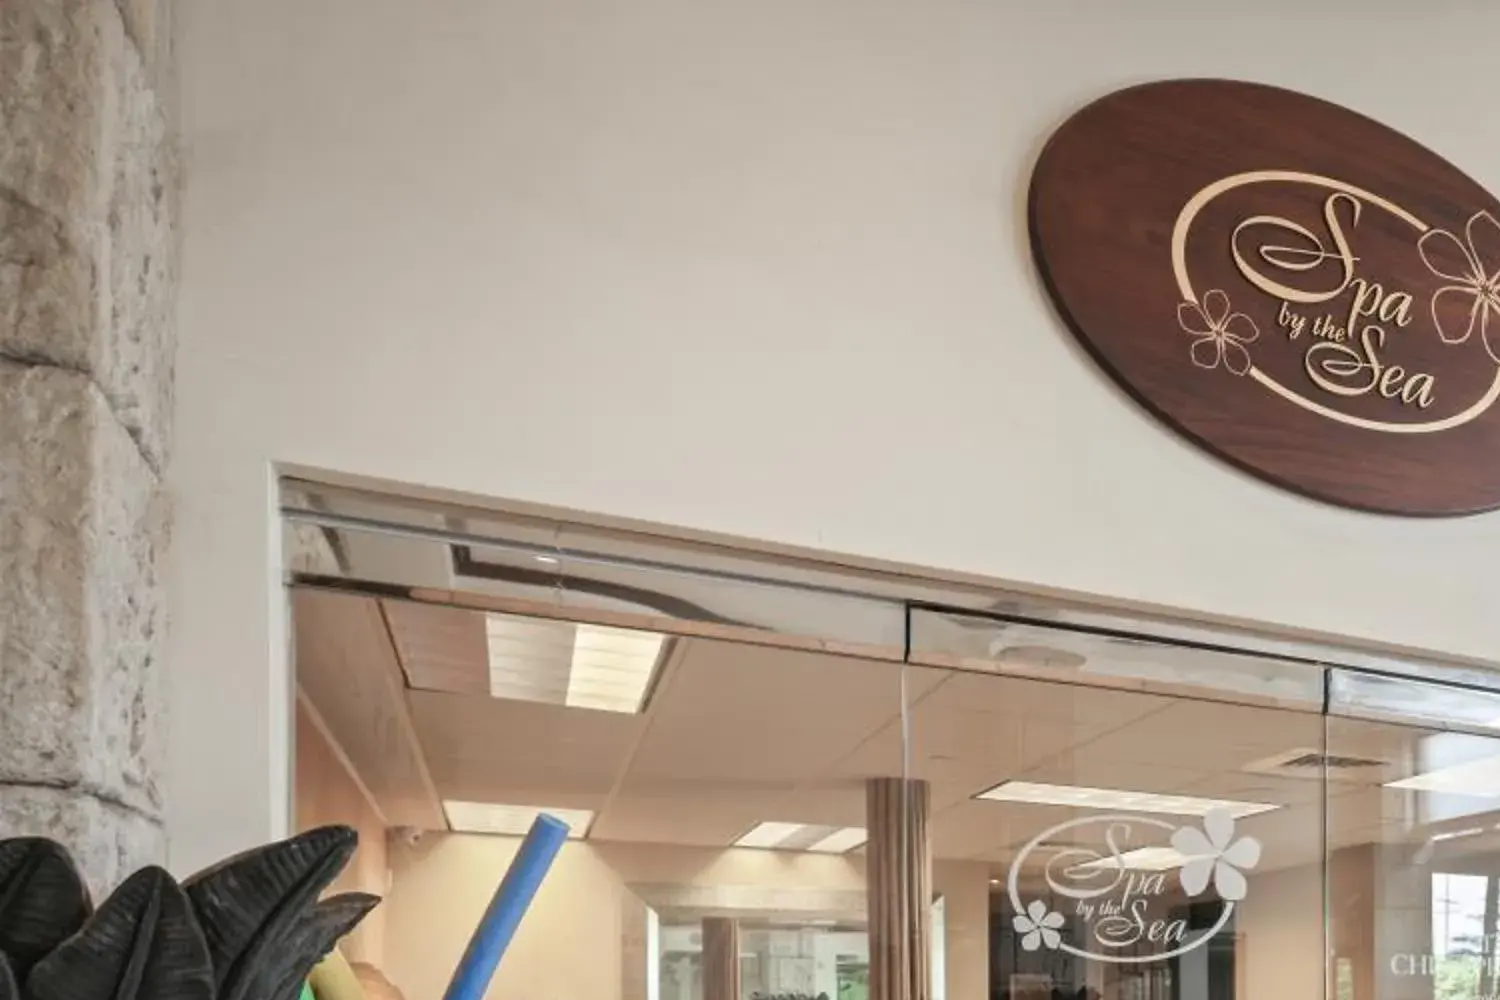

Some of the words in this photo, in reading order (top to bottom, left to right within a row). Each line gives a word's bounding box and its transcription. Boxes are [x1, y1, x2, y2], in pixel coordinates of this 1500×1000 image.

[1232, 192, 1413, 337] Spa
[1278, 302, 1304, 339] by
[1311, 314, 1344, 343] the
[1305, 326, 1434, 408] Sea
[1045, 823, 1166, 907] Spa
[1076, 900, 1094, 920] by
[1099, 899, 1121, 915] the
[1094, 899, 1187, 947] Sea
